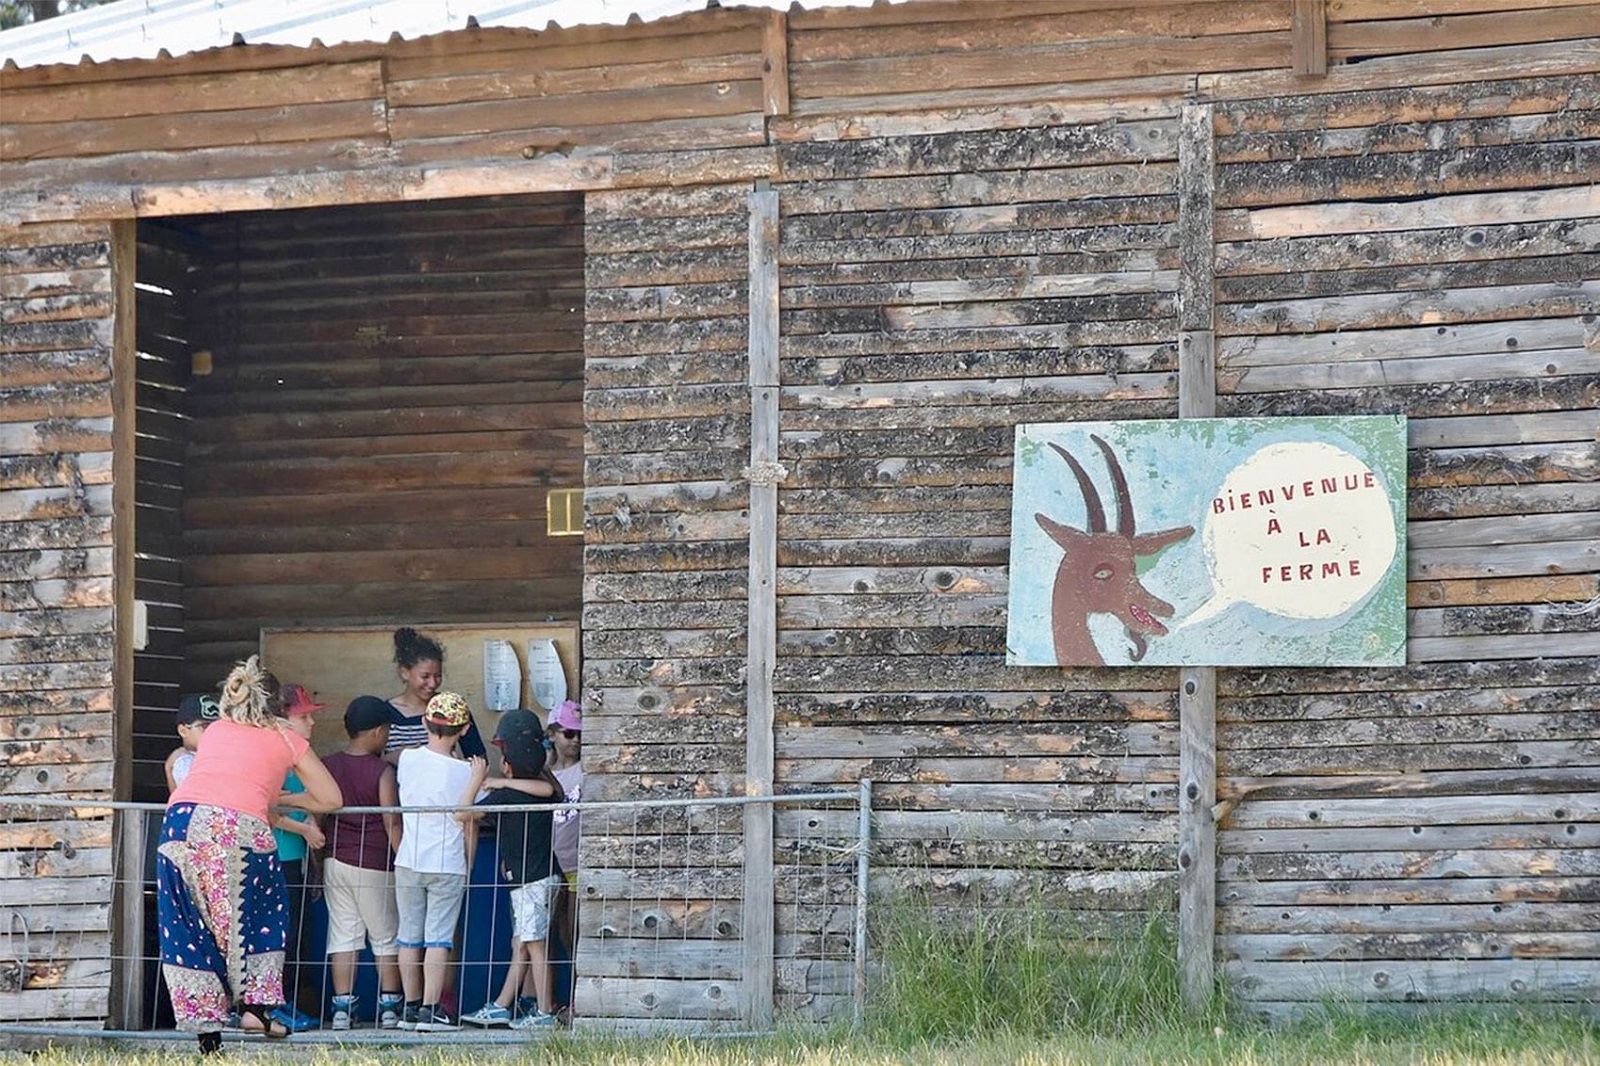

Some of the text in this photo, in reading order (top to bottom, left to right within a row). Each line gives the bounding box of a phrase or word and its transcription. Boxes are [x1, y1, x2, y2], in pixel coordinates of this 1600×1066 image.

[1267, 509, 1331, 547] À LA
[1262, 560, 1360, 583] FERME
